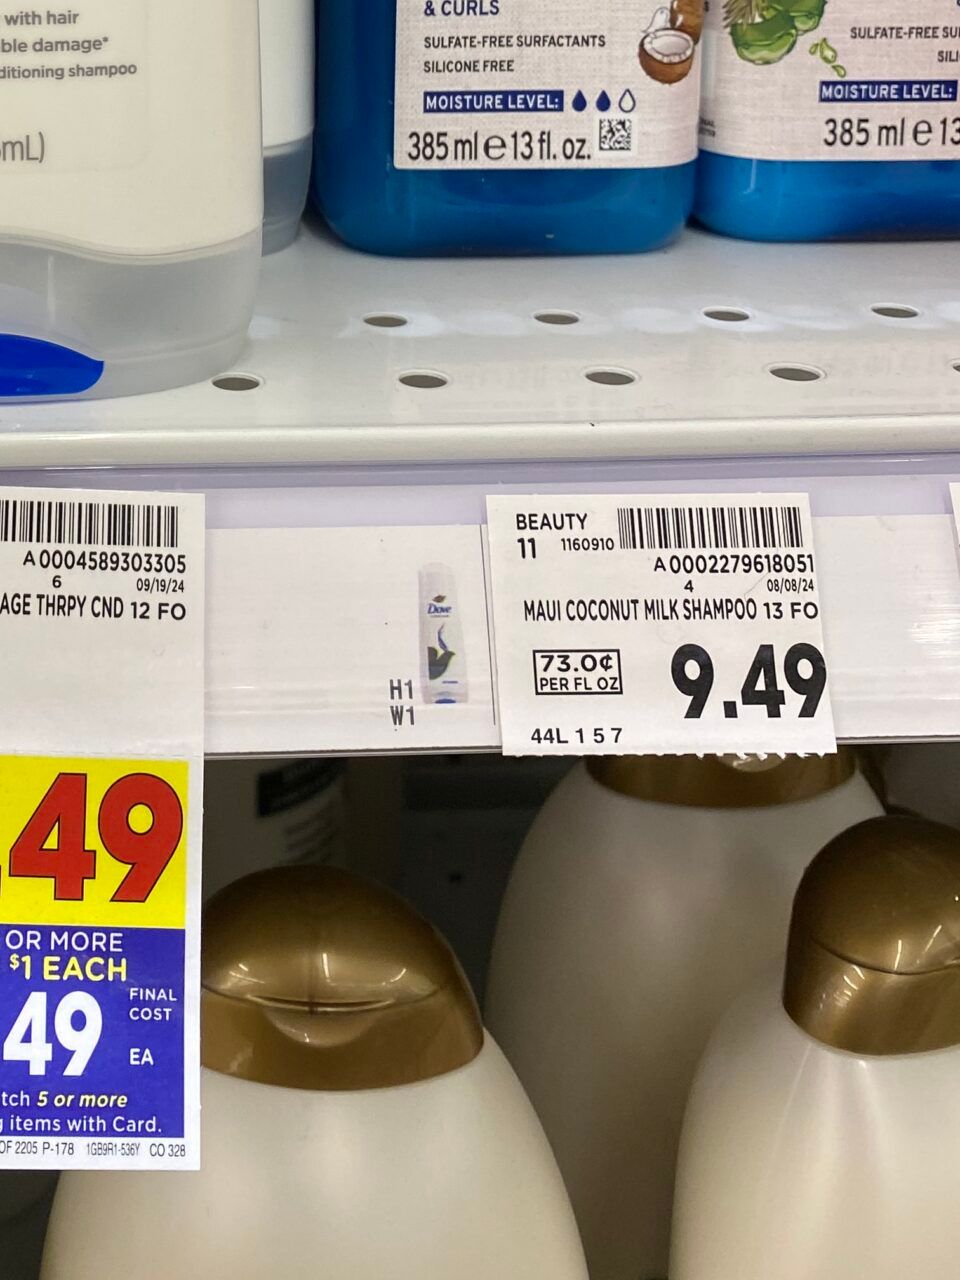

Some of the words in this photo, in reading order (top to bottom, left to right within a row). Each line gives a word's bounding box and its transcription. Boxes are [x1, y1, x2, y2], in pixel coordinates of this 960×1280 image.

[424, 1, 435, 16] &
[441, 0, 500, 16] CURLS
[4, 11, 42, 26] with
[46, 10, 79, 25] hair
[850, 27, 939, 39] SULFATE-FREE
[424, 36, 513, 49] SULFATE-FREE
[516, 35, 606, 48] SURFACTANTS
[68, 63, 137, 79] shampoo
[424, 61, 480, 73] SILICONE
[483, 60, 514, 72] FREE
[821, 85, 899, 99] MOISTURE
[903, 84, 952, 99] LEVEL:
[426, 95, 503, 109] MOISTURE
[508, 95, 559, 109] LEVEL:
[824, 118, 870, 147] 385
[877, 117, 905, 146] ml
[408, 132, 448, 161] 385
[454, 131, 478, 160] ml
[510, 131, 533, 160] 13
[537, 130, 557, 160] fl.
[562, 139, 591, 160] oz.
[515, 514, 588, 531] BEAUTY
[517, 538, 537, 559] 11
[561, 538, 614, 551] 1160910
[52, 576, 62, 589] 6
[136, 578, 185, 594] 09/19/24
[684, 580, 694, 593] 4
[766, 578, 814, 594] 08/08/24
[36, 594, 86, 617] THRPY
[90, 596, 124, 618] CND
[131, 602, 150, 619] 12
[158, 603, 186, 621] FO
[523, 600, 561, 621] MAUI
[565, 599, 639, 621] COCONUT
[645, 599, 679, 621] MILK
[683, 598, 757, 620] SHAMPOO
[764, 602, 784, 619] 13
[791, 602, 819, 620] FO
[540, 654, 613, 673] 73.0¢
[540, 677, 569, 691] PER
[574, 677, 593, 691] FL
[597, 677, 619, 691] OZ
[671, 643, 826, 719] 9.49
[389, 680, 413, 700] H1
[391, 706, 415, 726] W1
[5, 929, 40, 950] OR
[50, 932, 123, 951] MORE
[10, 955, 32, 980] $1
[43, 956, 127, 981] EACH
[130, 988, 177, 1001] FINAL
[129, 1007, 172, 1021] COST
[130, 1049, 154, 1065] EA
[37, 1091, 48, 1107] 5
[54, 1094, 75, 1108] or
[80, 1094, 128, 1109] more
[8, 1115, 61, 1131] items
[66, 1116, 107, 1132] with
[112, 1117, 162, 1133] Card.
[15, 1141, 37, 1154] 2205
[42, 1142, 74, 1155] P-178
[150, 1144, 165, 1156] CO
[168, 1144, 186, 1157] 328
